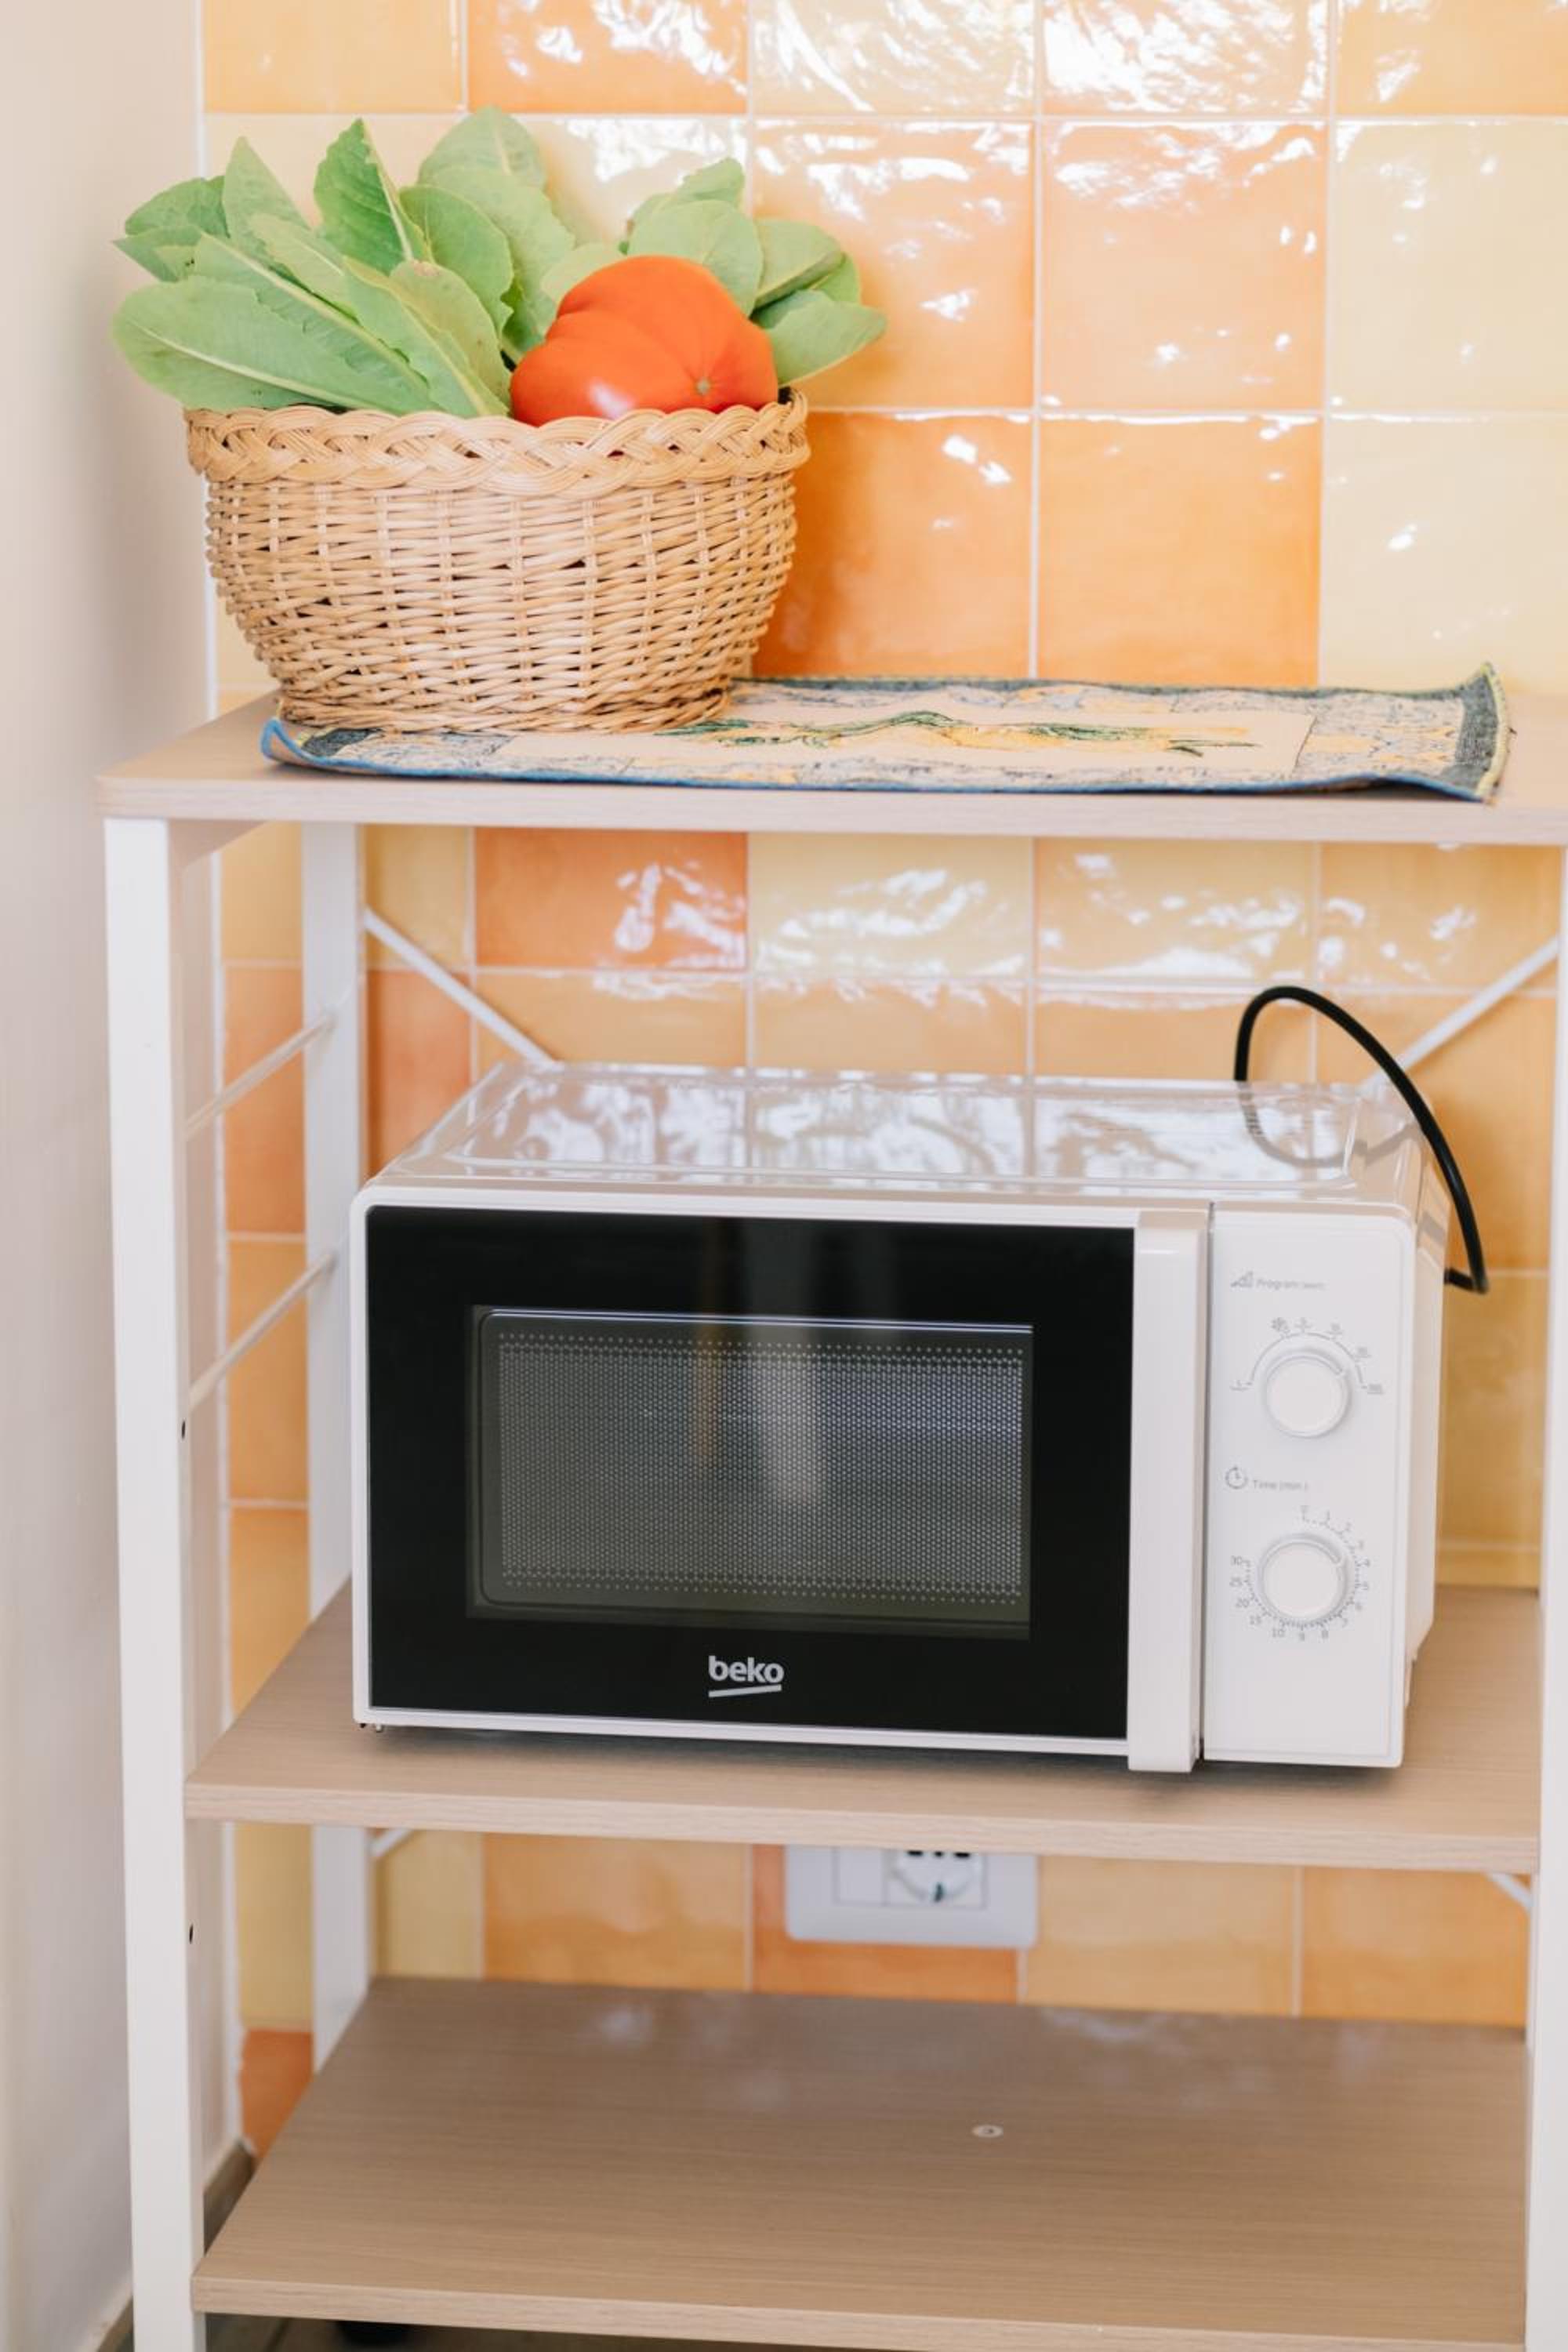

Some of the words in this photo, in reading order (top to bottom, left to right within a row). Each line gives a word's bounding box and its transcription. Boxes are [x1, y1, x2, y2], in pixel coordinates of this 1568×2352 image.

[1256, 1279, 1298, 1290] Program
[1252, 1479, 1277, 1490] Time
[1235, 1598, 1250, 1609] 20
[1272, 1628, 1286, 1638] 10
[708, 1655, 785, 1683] beko
